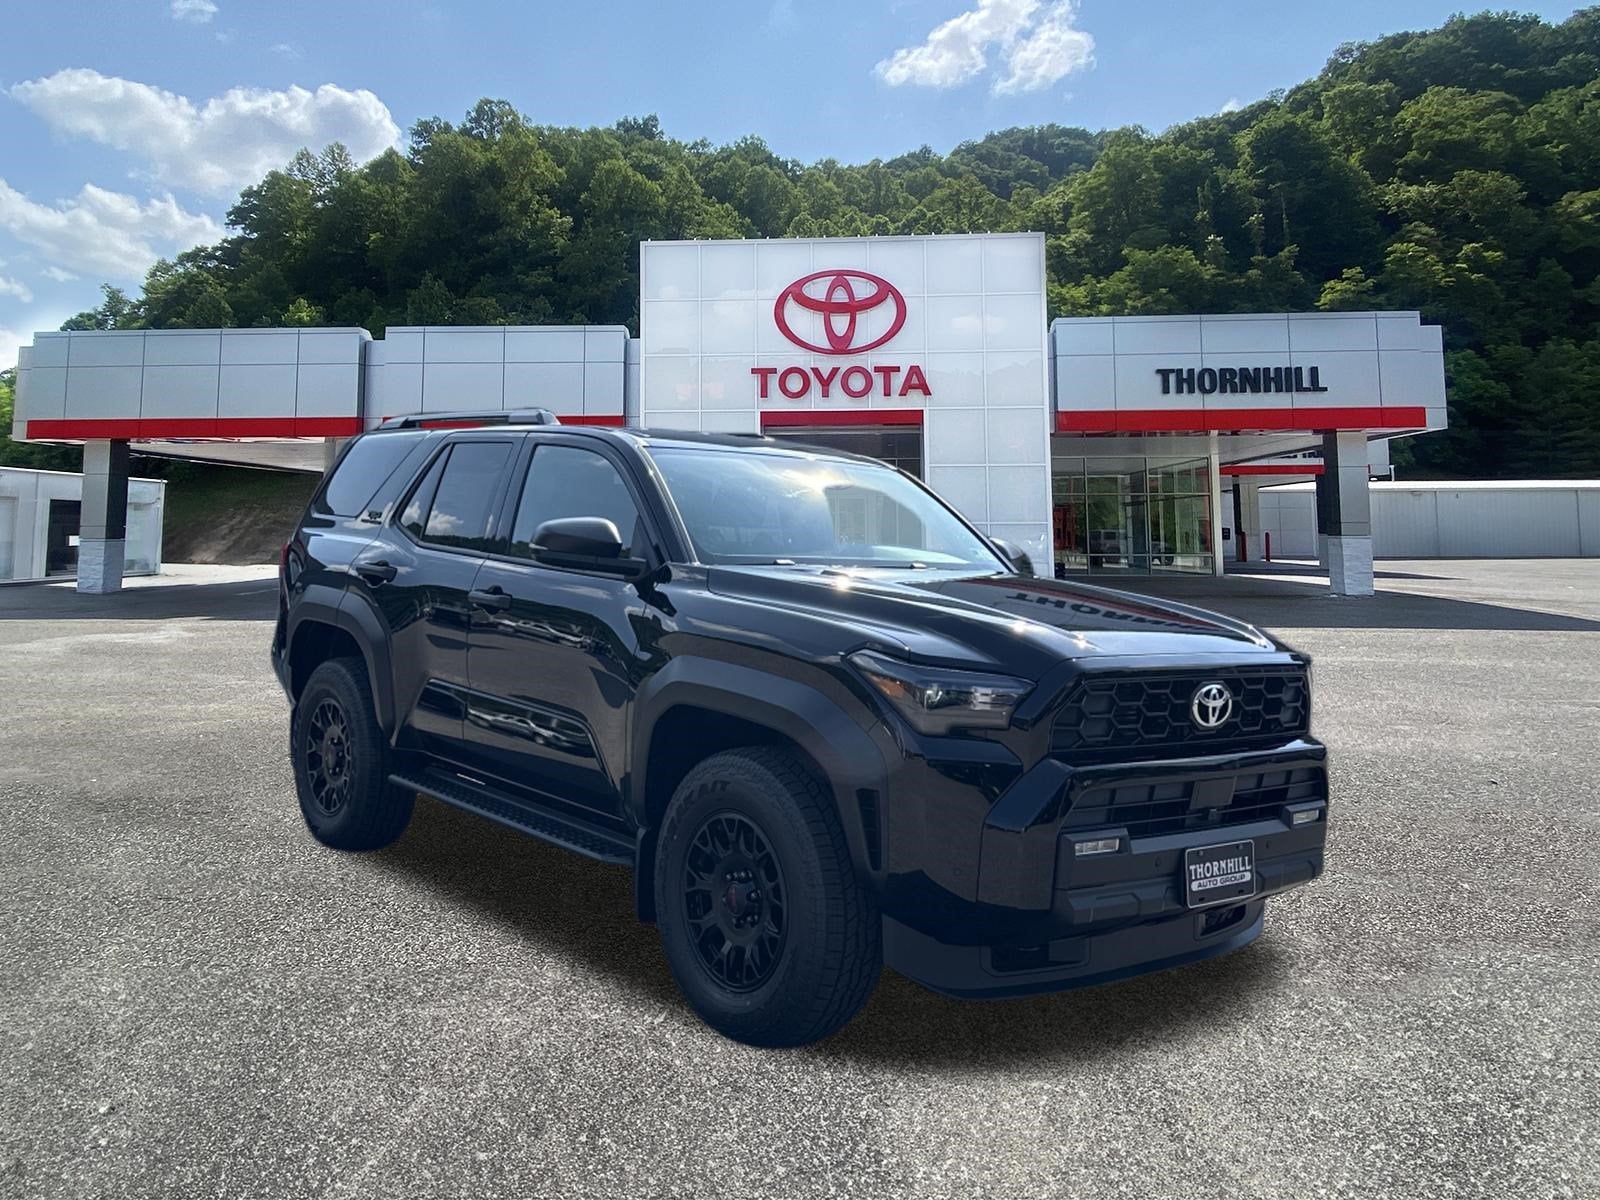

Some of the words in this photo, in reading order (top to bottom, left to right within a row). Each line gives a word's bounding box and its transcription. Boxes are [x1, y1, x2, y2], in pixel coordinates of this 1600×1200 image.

[751, 365, 932, 399] TOYOTA
[1155, 366, 1328, 395] THORNHILL
[1189, 856, 1252, 880] THORNHILL
[1197, 878, 1218, 889] AUTO
[1219, 873, 1246, 885] GROUP
